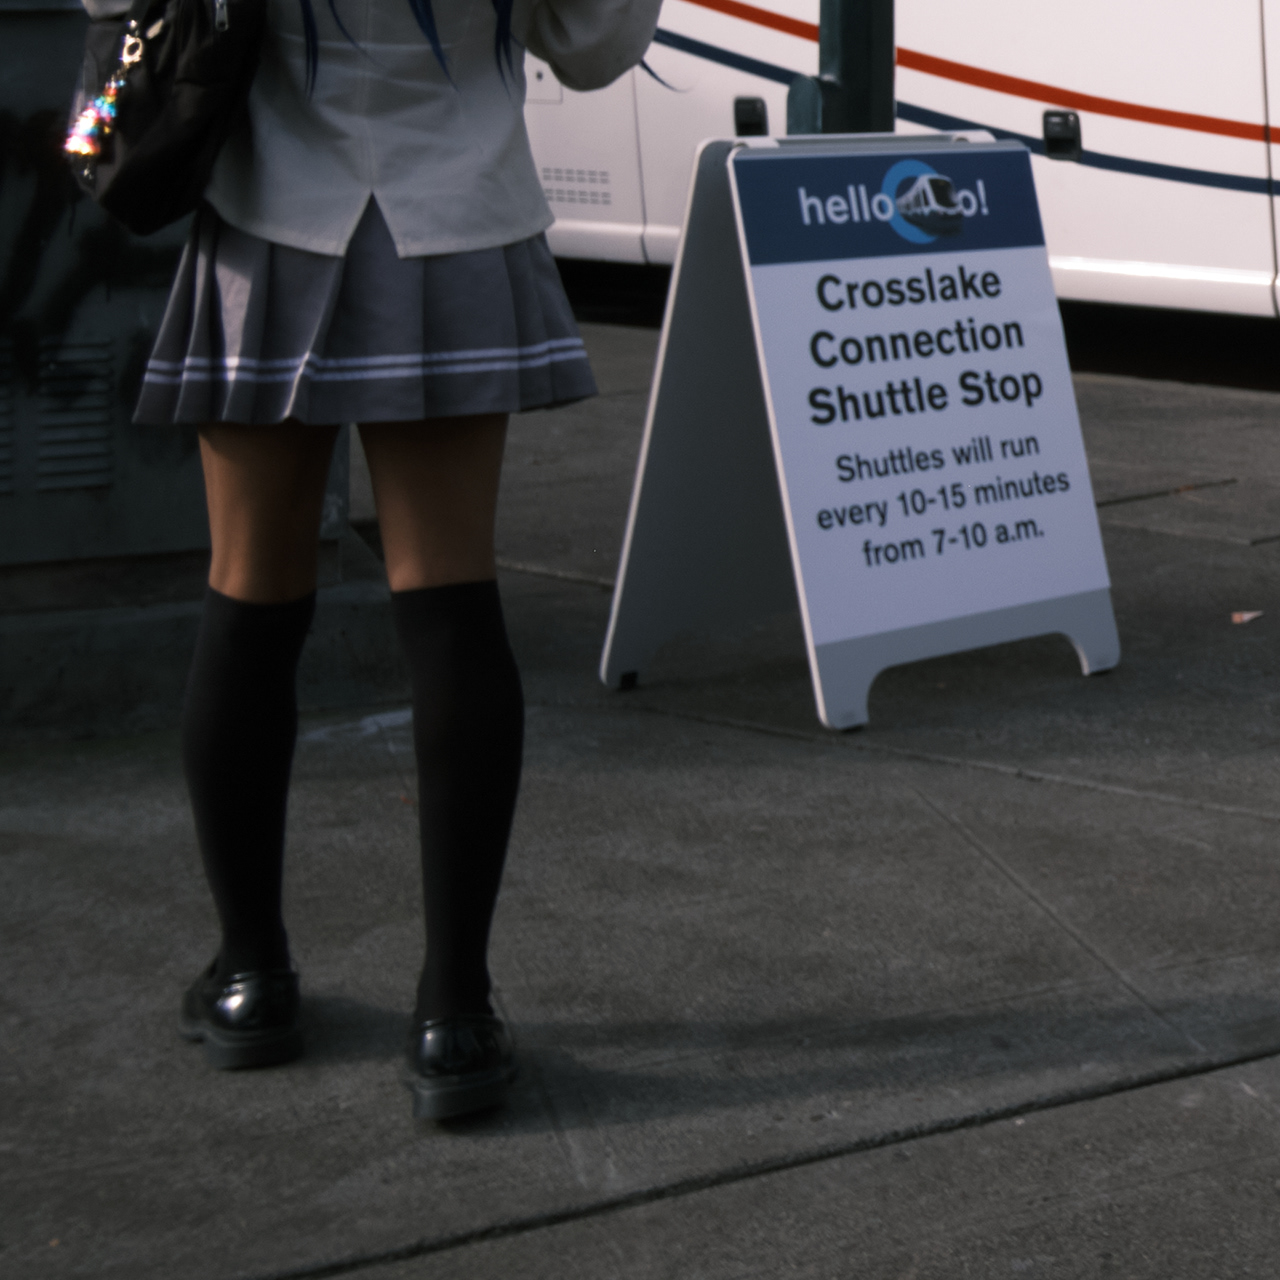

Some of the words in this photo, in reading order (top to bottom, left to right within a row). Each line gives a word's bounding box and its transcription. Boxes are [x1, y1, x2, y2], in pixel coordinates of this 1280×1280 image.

[798, 183, 894, 226] hello
[816, 265, 1002, 311] Crosslake
[810, 317, 1024, 368] Connection
[808, 376, 948, 425] Shuttle
[959, 370, 1043, 408] Stop
[836, 446, 945, 482] Shuttles
[952, 435, 994, 465] will
[1000, 434, 1040, 459] run
[817, 500, 888, 531] every
[897, 482, 967, 517] 10-15
[974, 471, 1071, 506] minutes
[863, 537, 925, 567] from
[931, 522, 988, 555] 7-10
[995, 518, 1044, 545] a.m.
